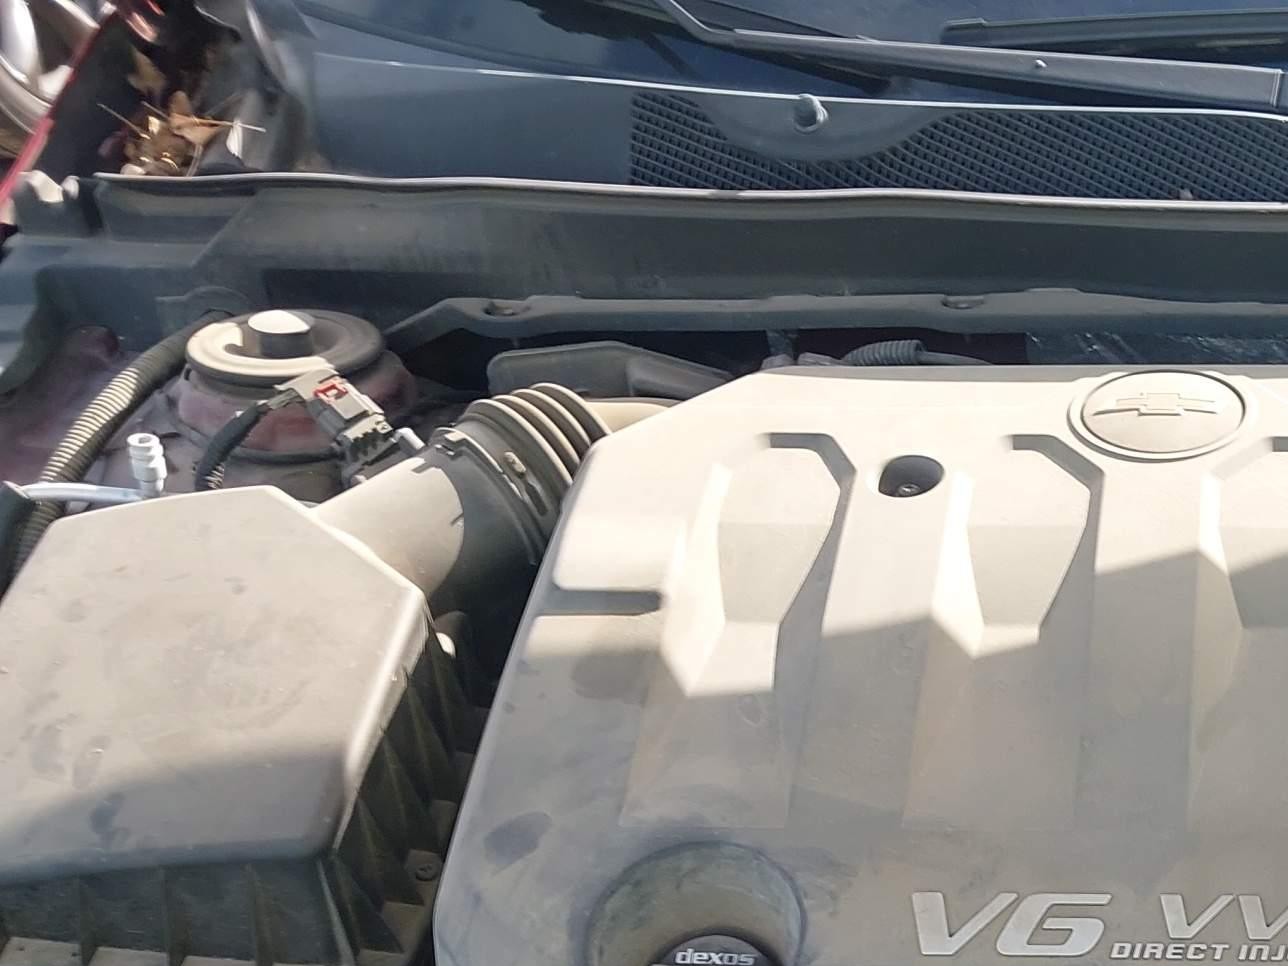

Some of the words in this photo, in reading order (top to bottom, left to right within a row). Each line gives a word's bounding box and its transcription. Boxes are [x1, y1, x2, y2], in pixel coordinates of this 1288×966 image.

[911, 891, 1112, 957] V6
[674, 948, 758, 966] dexos
[1110, 942, 1229, 961] DIRECT
